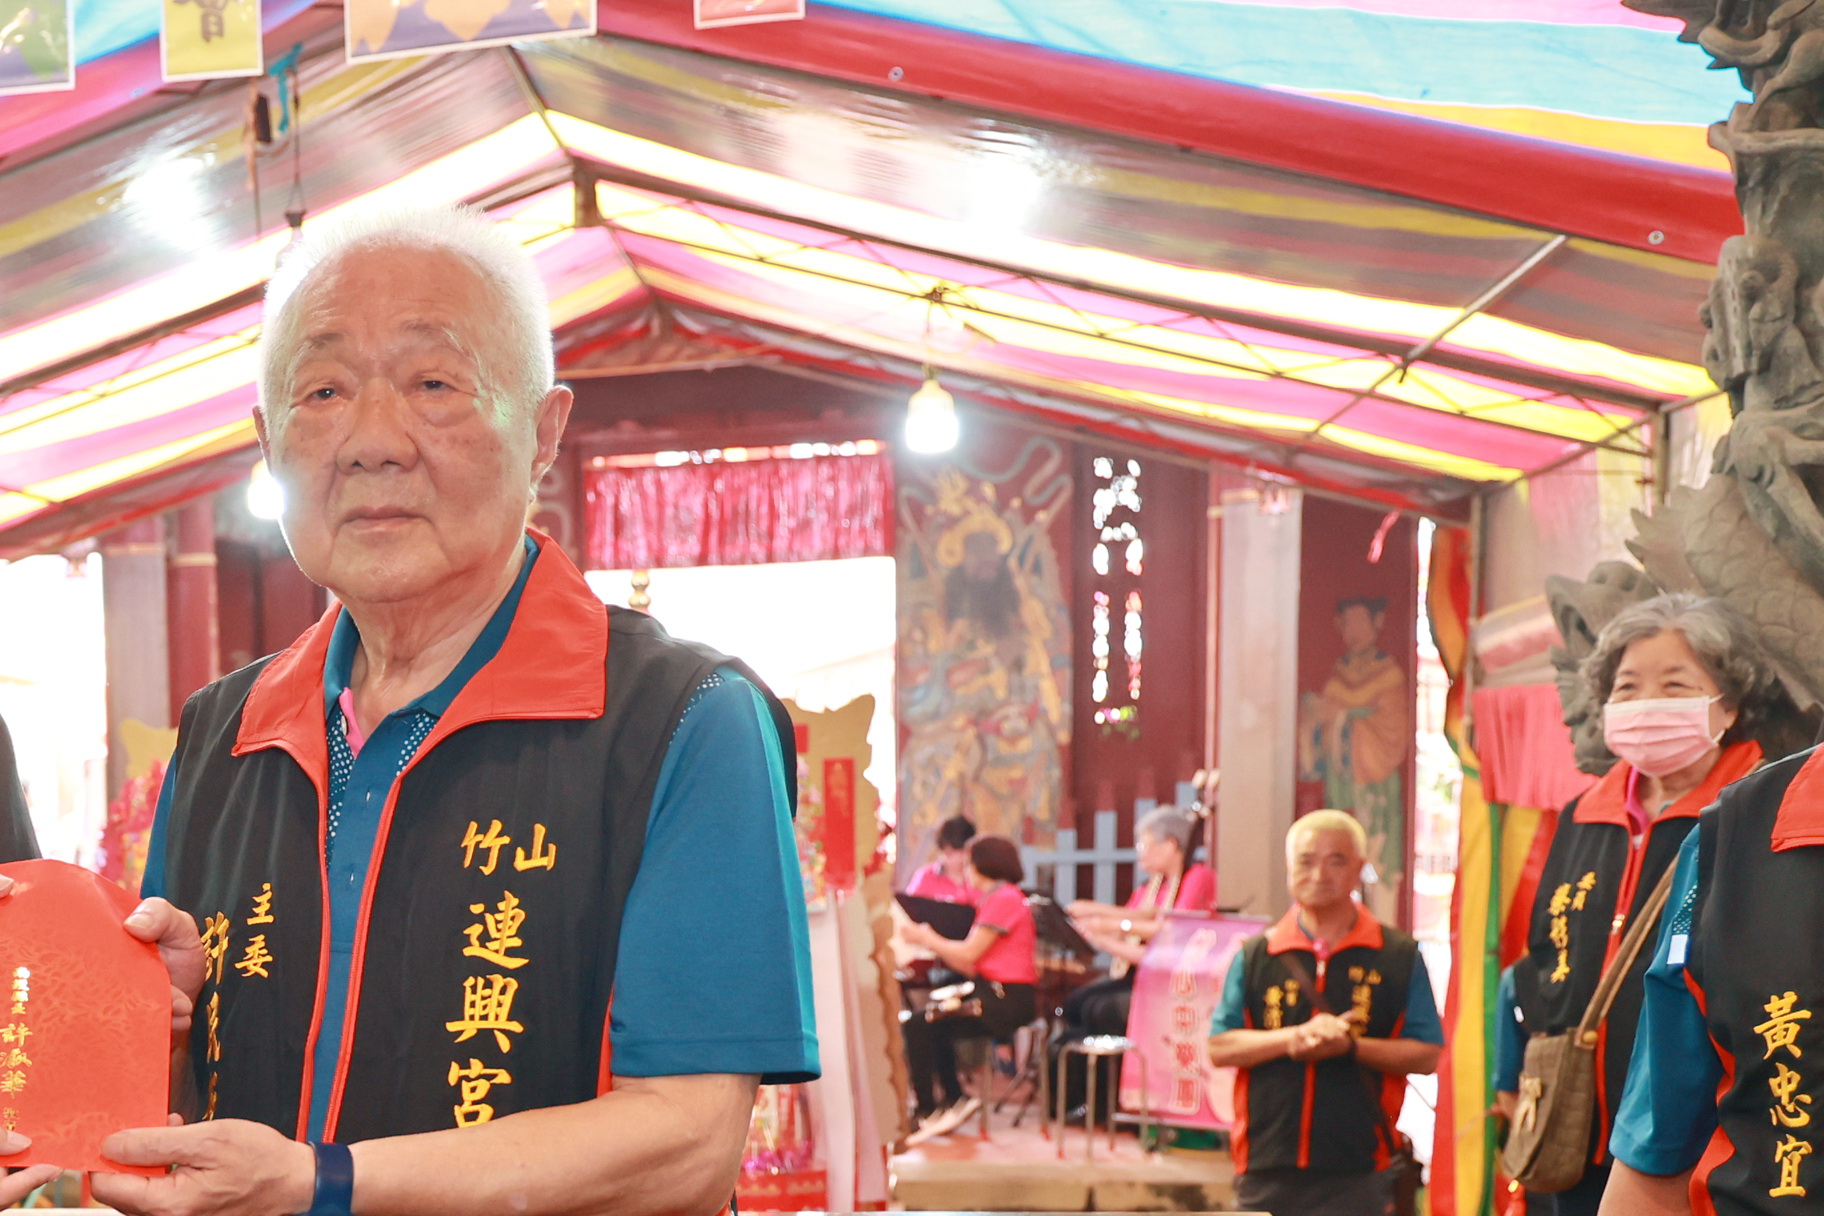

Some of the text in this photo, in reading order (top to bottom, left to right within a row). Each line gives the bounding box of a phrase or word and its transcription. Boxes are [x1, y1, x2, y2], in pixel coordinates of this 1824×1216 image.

[460, 818, 558, 876] 竹山
[234, 882, 276, 979] 主委
[445, 889, 530, 1128] 連興宮
[1752, 990, 1813, 1198] 黃忠宜
